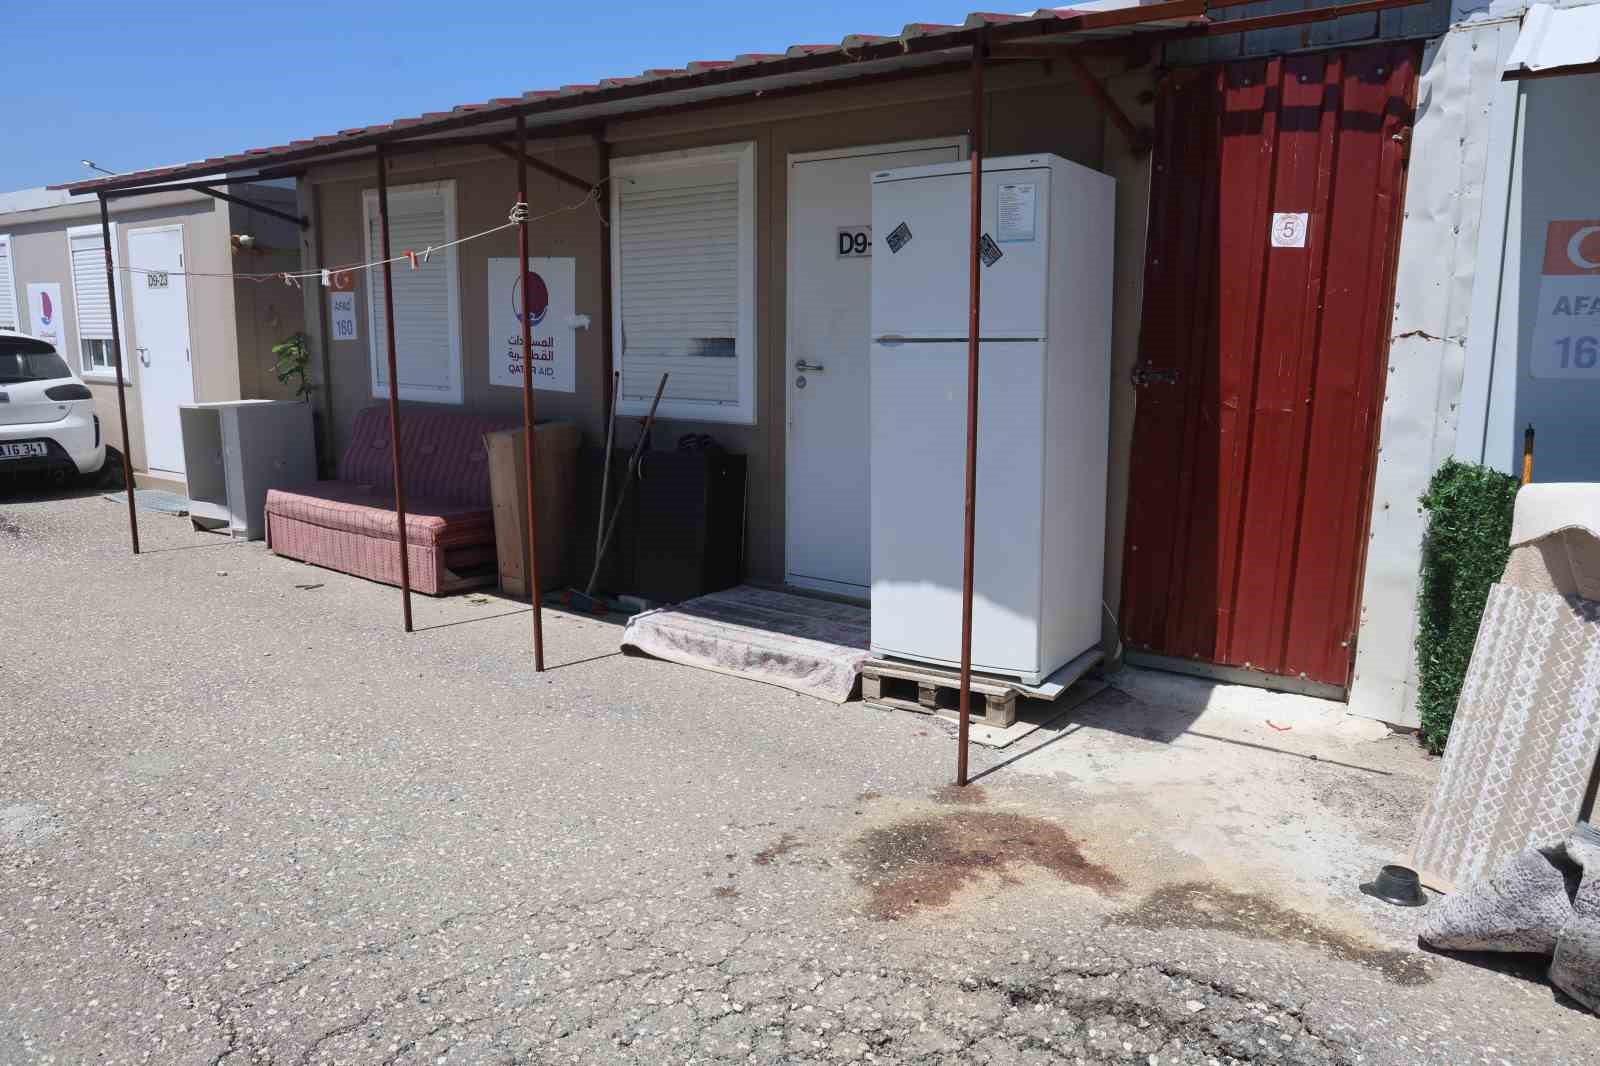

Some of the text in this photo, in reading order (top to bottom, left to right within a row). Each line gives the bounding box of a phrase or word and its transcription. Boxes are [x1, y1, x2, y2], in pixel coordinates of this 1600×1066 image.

[1282, 221, 1295, 238] 5
[839, 232, 872, 254] D9-
[336, 319, 353, 337] 160
[508, 335, 554, 348] المسدات
[1554, 335, 1599, 369] 16
[508, 364, 554, 376] QATR AID
[22, 443, 42, 456] 341
